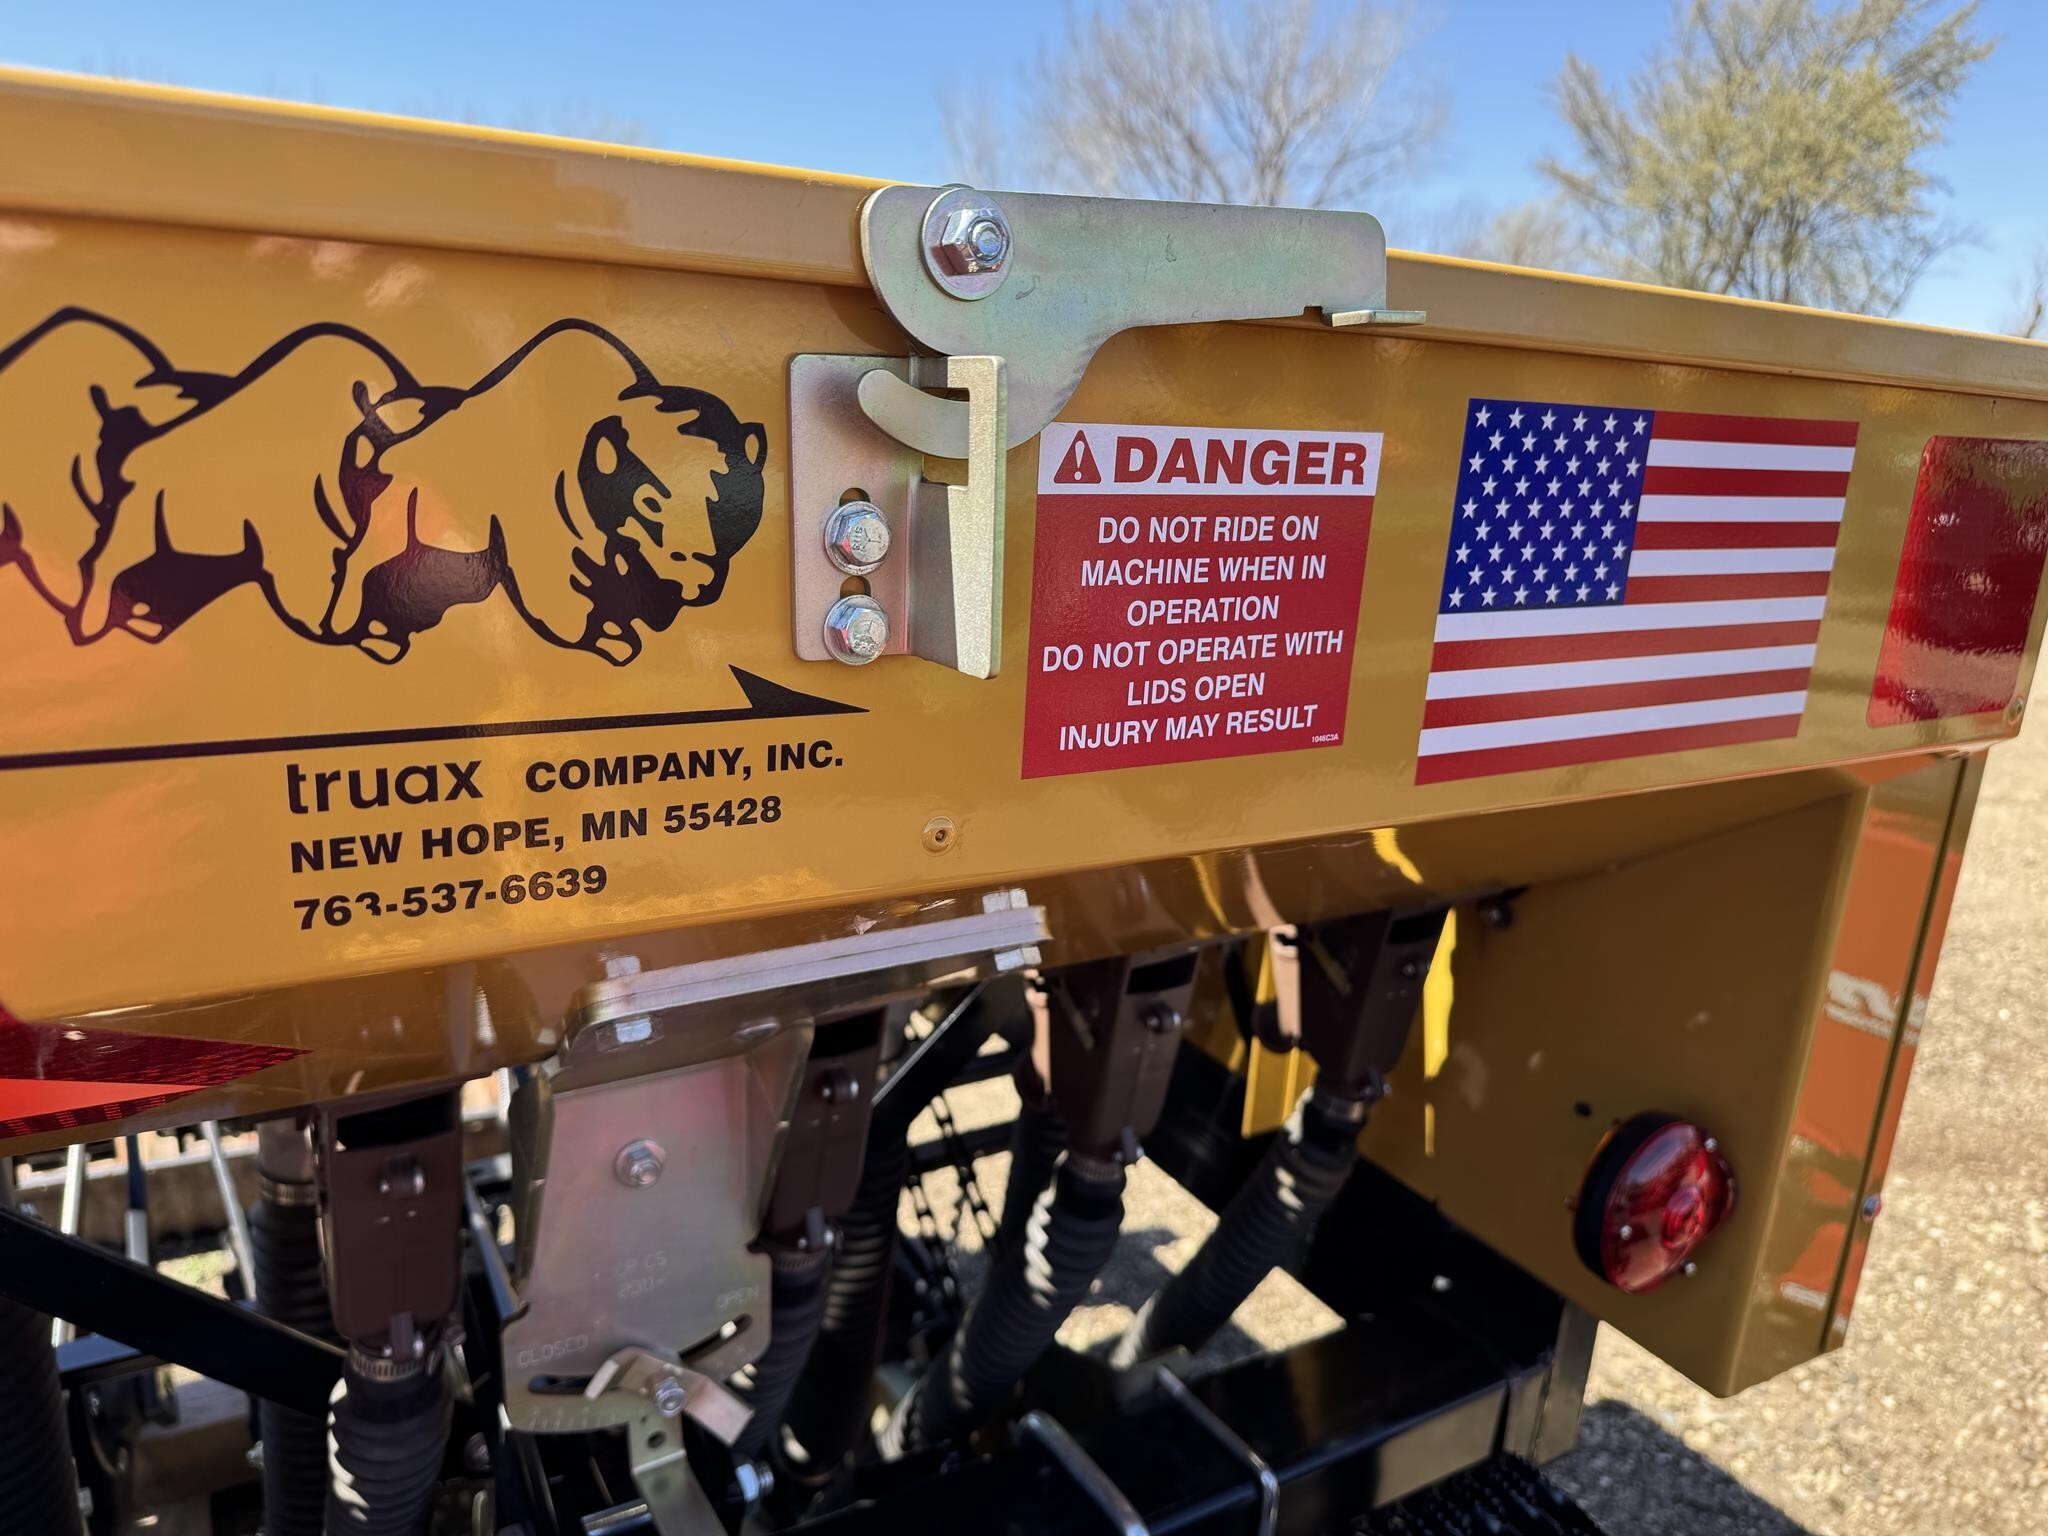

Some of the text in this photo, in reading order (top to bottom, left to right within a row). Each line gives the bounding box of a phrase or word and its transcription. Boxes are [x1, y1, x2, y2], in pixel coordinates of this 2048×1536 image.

[1113, 435, 1367, 486] DANGER
[1098, 515, 1320, 544] DO NOT RIDE ON
[1081, 555, 1327, 587] MACHINE WHEN IN
[1126, 595, 1280, 627] OPERATION
[1042, 630, 1344, 672] DO NOT OPERATE WITH
[1127, 672, 1266, 706] LIDS OPEN
[1059, 704, 1319, 751] INJURY MAY RESULT
[286, 739, 843, 815] truax COMPANY, INC.
[290, 795, 782, 874] NEW HOPE, MN 55428
[293, 864, 607, 931] 763-537-6639
[518, 1334, 589, 1368] CLOSED
